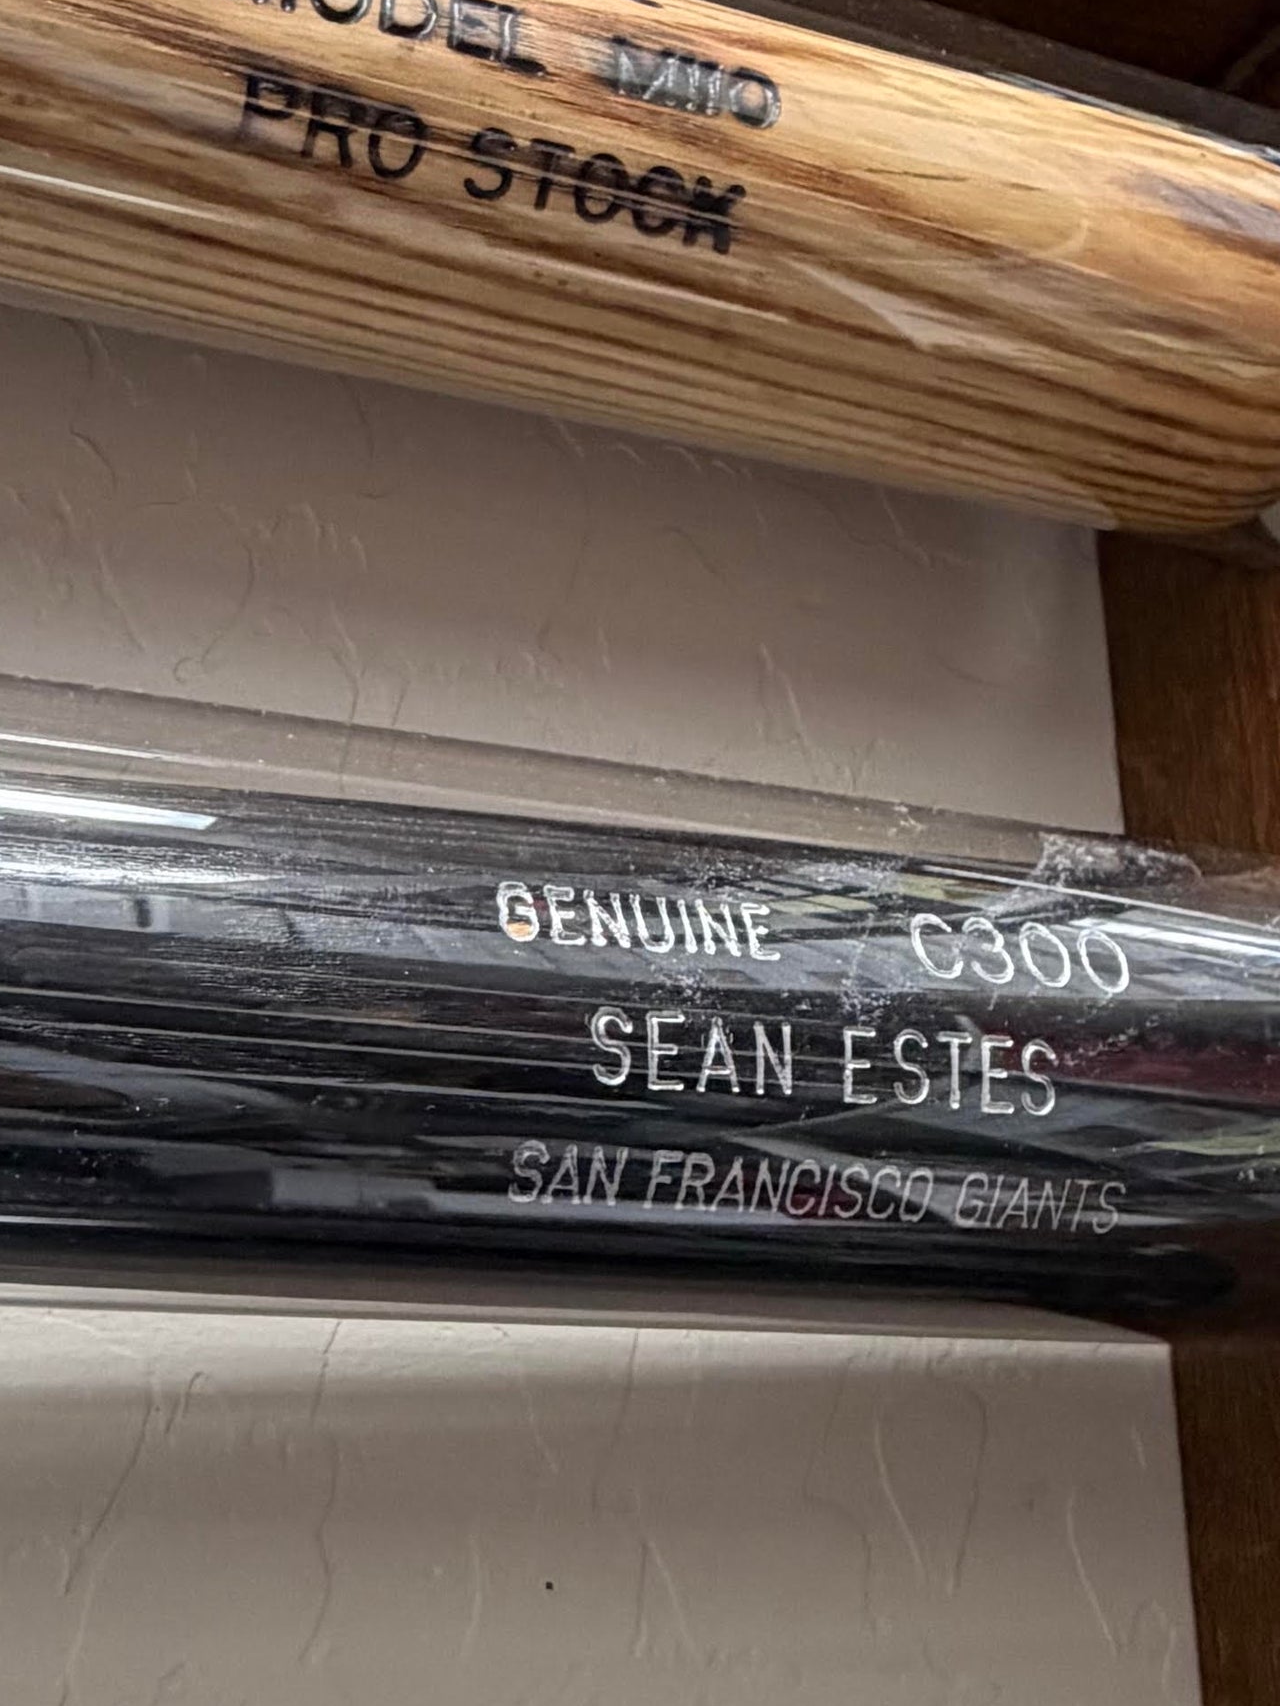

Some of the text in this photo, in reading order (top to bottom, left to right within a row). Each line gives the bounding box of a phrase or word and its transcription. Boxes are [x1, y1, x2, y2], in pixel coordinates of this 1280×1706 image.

[240, 71, 747, 256] PRO STOCK
[496, 881, 1132, 995] GENUINE C300
[590, 1006, 1059, 1118] SEAN ESTES
[508, 1139, 1128, 1236] SAN FRANCISCO GIANTS
